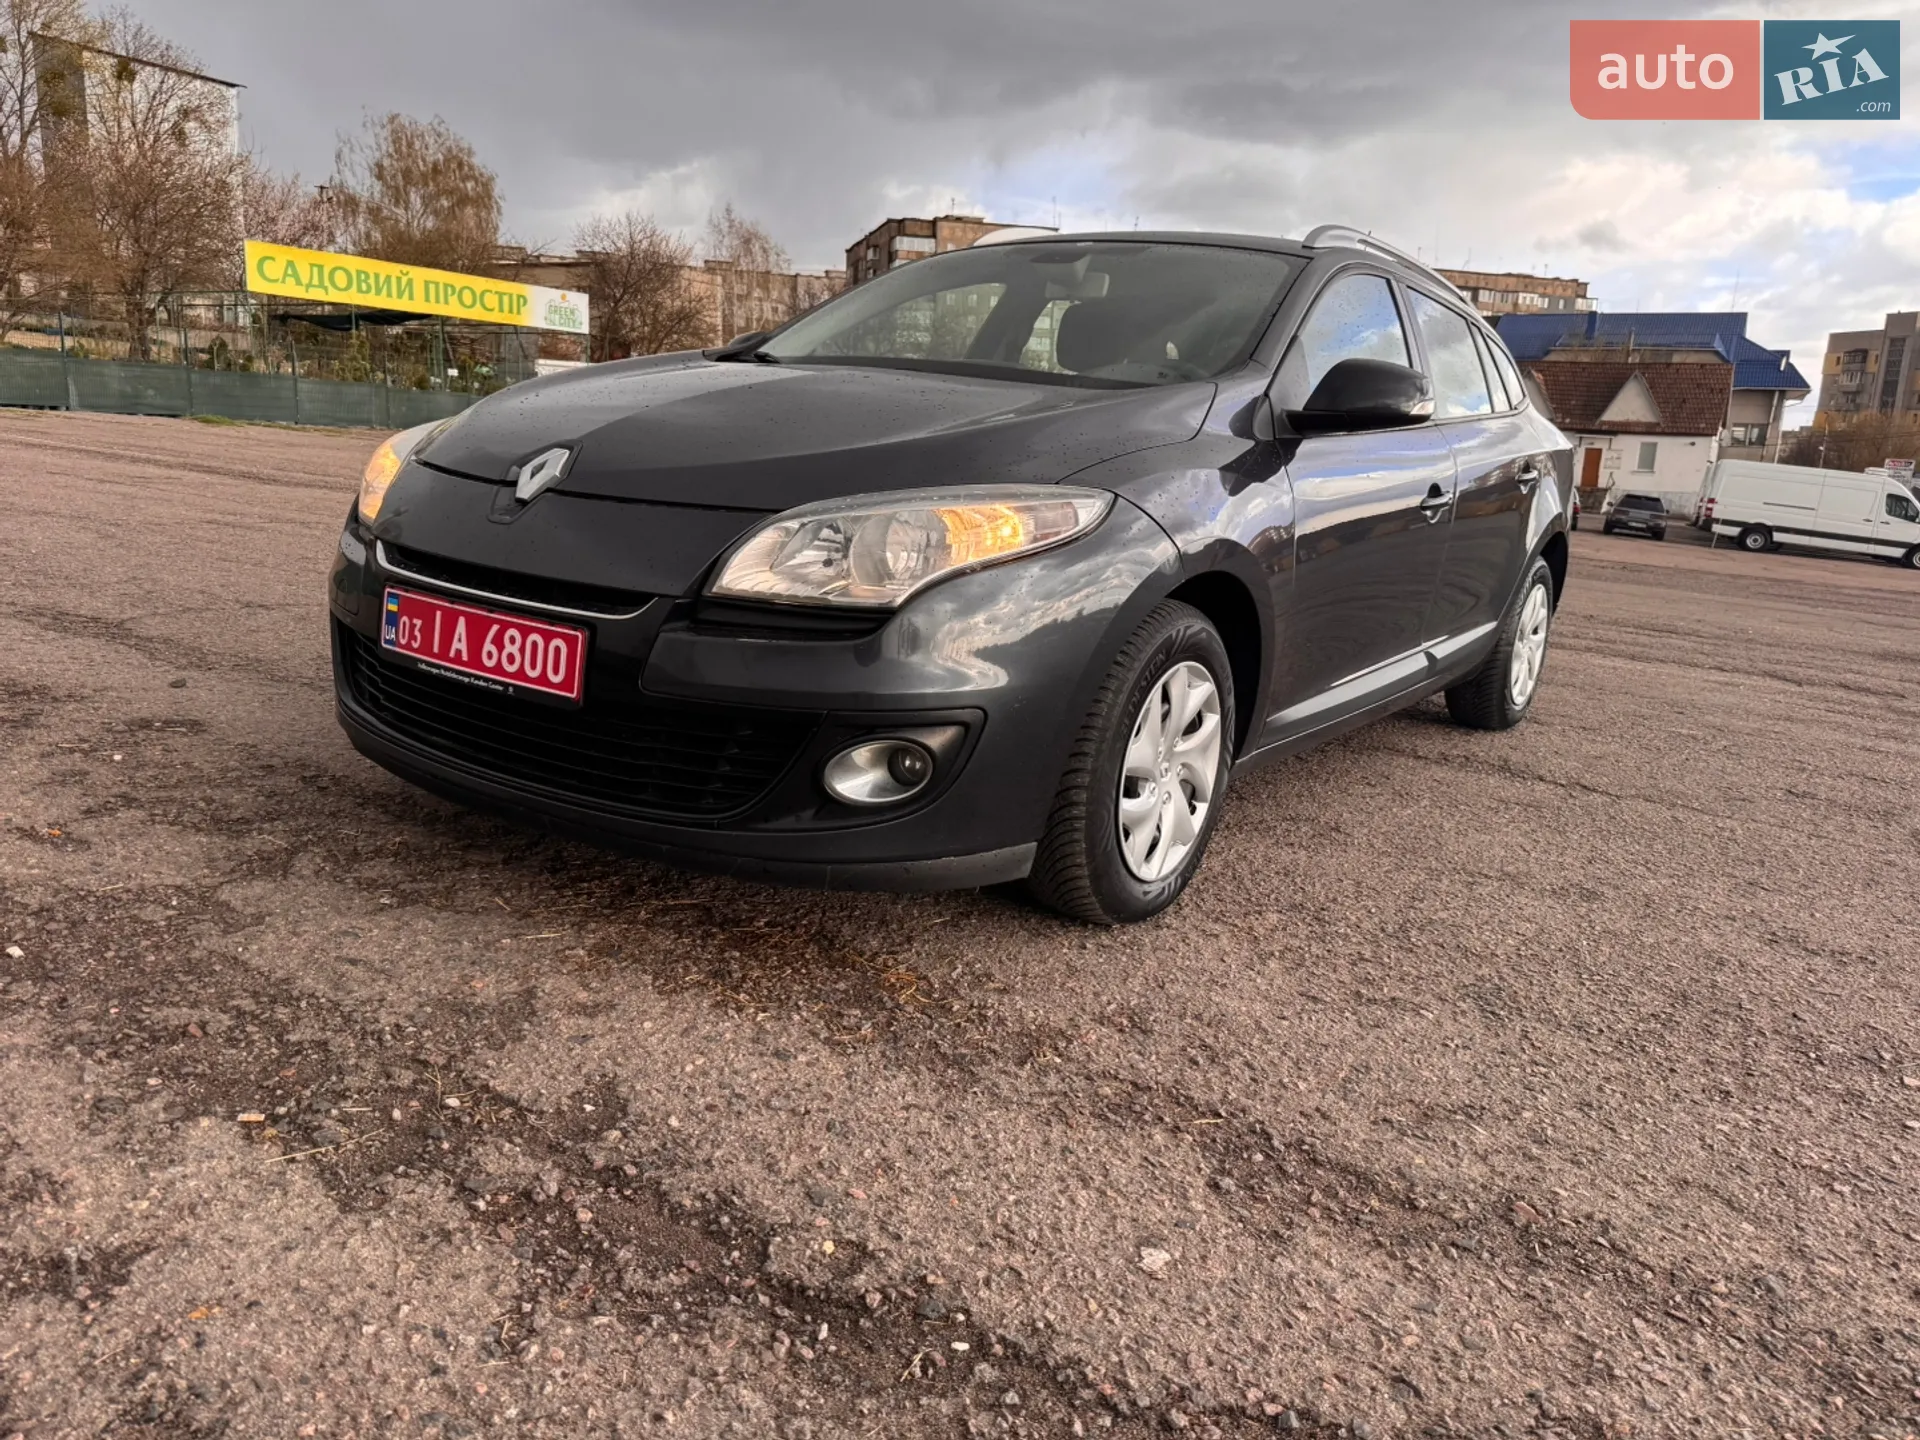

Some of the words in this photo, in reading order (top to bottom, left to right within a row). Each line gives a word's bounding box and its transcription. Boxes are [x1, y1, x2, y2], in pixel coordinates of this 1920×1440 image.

[256, 255, 415, 301] САДОВИЙ
[423, 279, 528, 316] ПРОСТІР
[548, 304, 576, 318] GREEN
[385, 624, 396, 641] UA
[399, 615, 423, 649] 03
[481, 624, 568, 685] 6800
